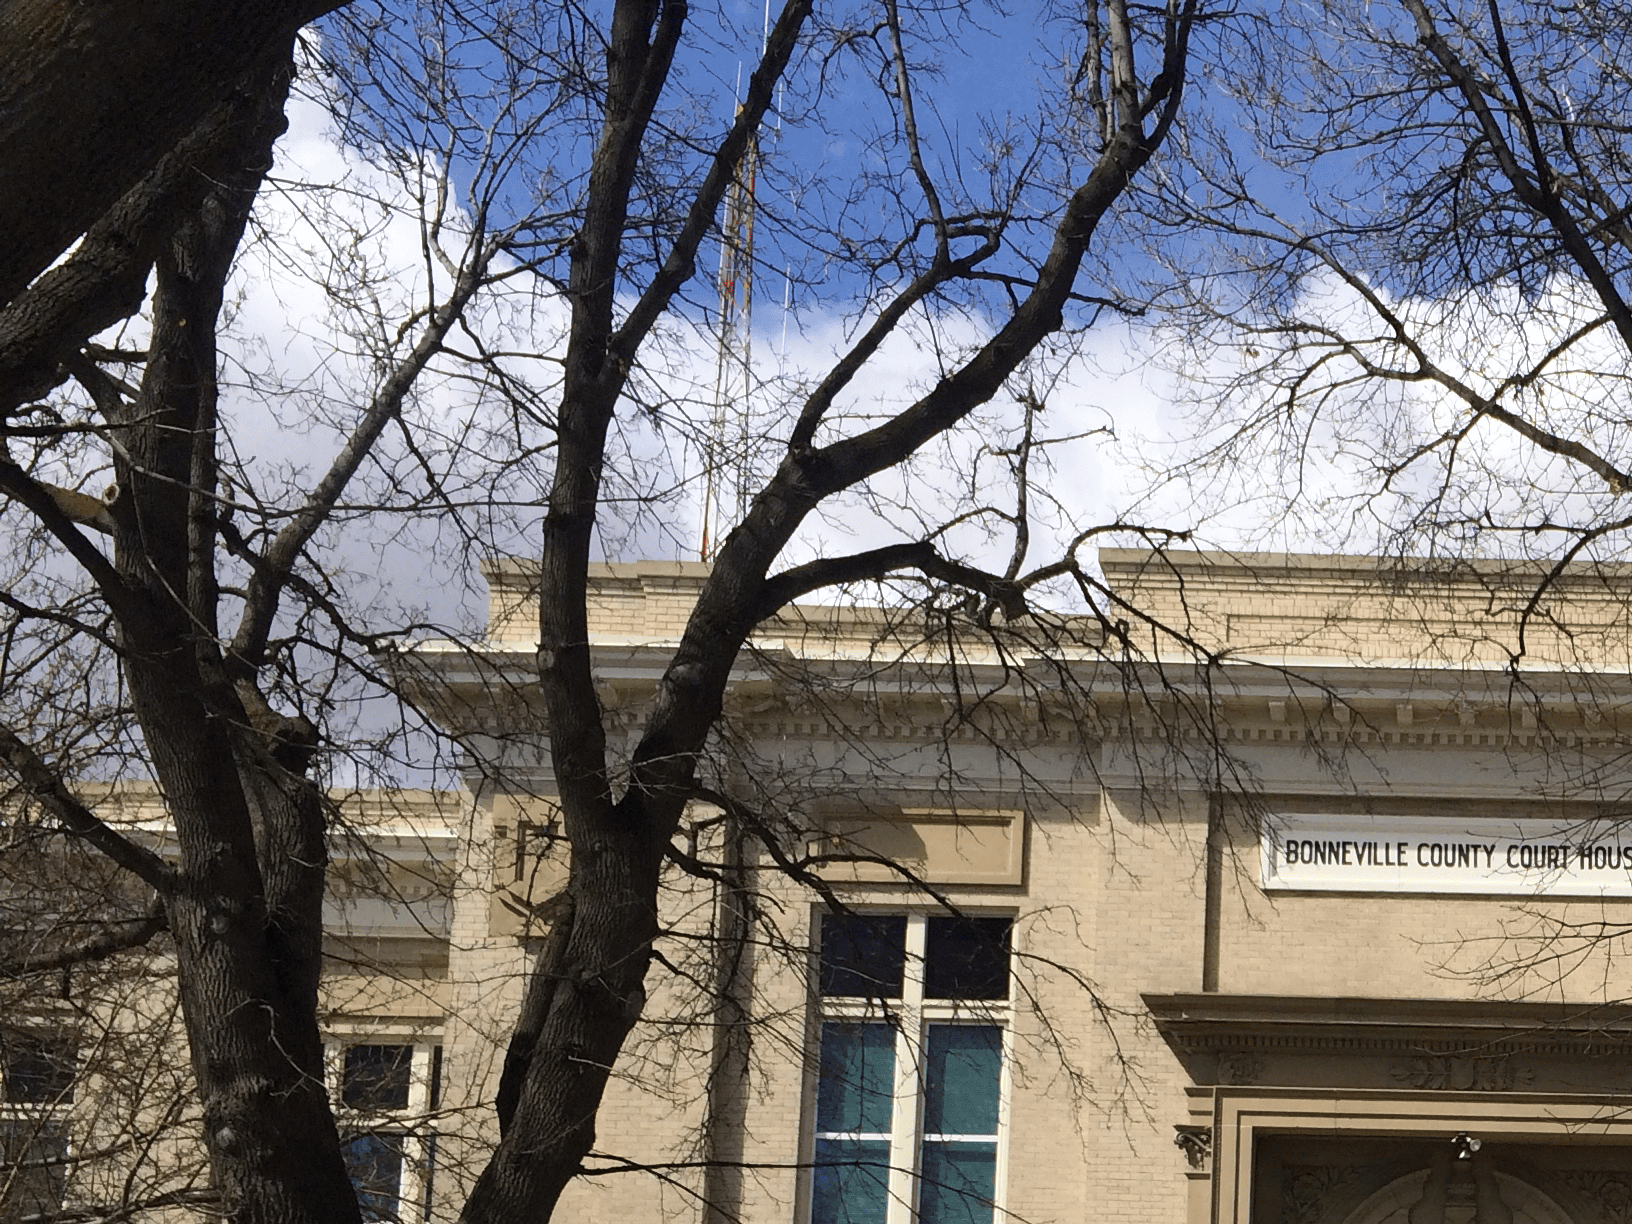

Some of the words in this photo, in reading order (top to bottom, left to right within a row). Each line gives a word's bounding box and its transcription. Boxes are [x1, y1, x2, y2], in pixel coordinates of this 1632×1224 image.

[1285, 839, 1409, 867] BONNEVILLE
[1416, 842, 1497, 869] COUNTY
[1506, 844, 1570, 870] COURT
